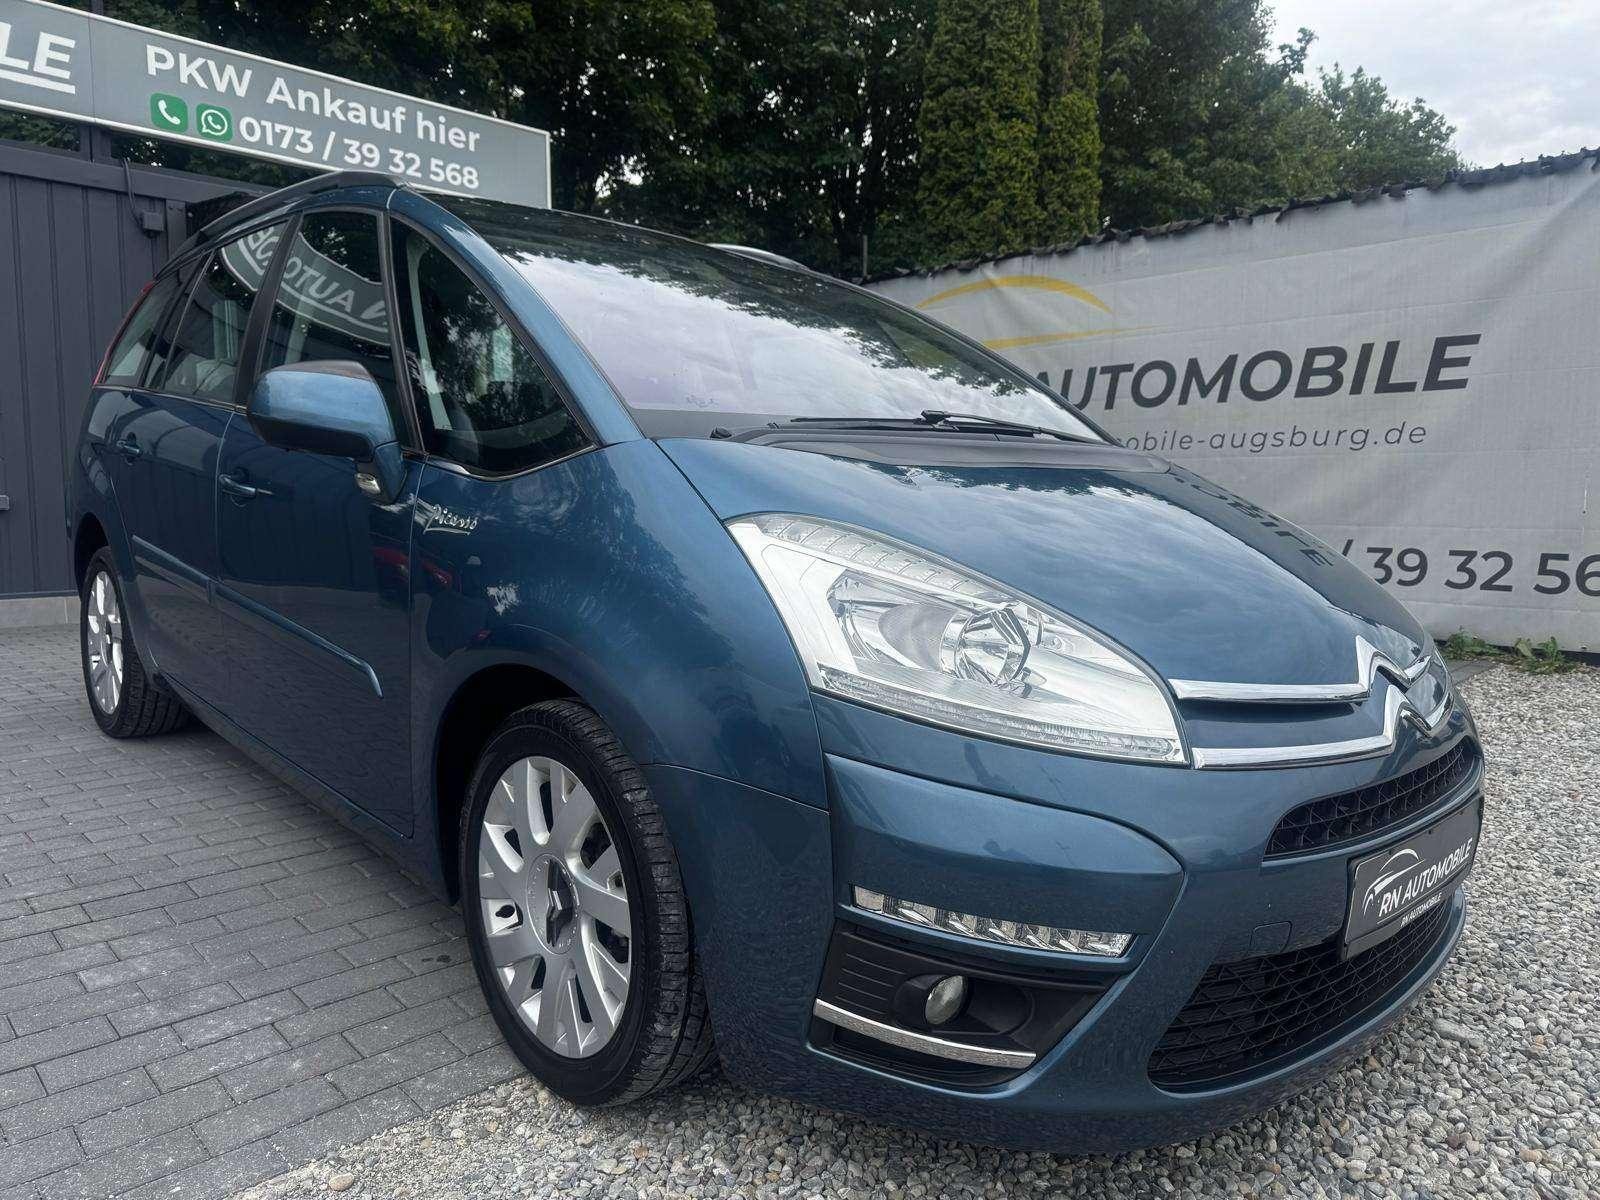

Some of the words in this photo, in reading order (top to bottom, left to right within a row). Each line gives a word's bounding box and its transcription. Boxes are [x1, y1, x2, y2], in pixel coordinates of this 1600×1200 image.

[146, 44, 253, 98] PKW
[266, 77, 406, 134] Ankauf
[416, 111, 480, 152] hier
[239, 116, 314, 154] 0173
[322, 131, 336, 161] /
[343, 138, 380, 168] 39
[388, 148, 422, 178] 32
[429, 157, 479, 189] 568
[1117, 421, 1427, 454] obile-augsburg.de
[1367, 547, 1428, 587] 39
[1444, 550, 1513, 592] 32
[1533, 552, 1600, 597] 56
[1378, 886, 1403, 917] RN
[1401, 838, 1473, 905] AUTOMOBILE
